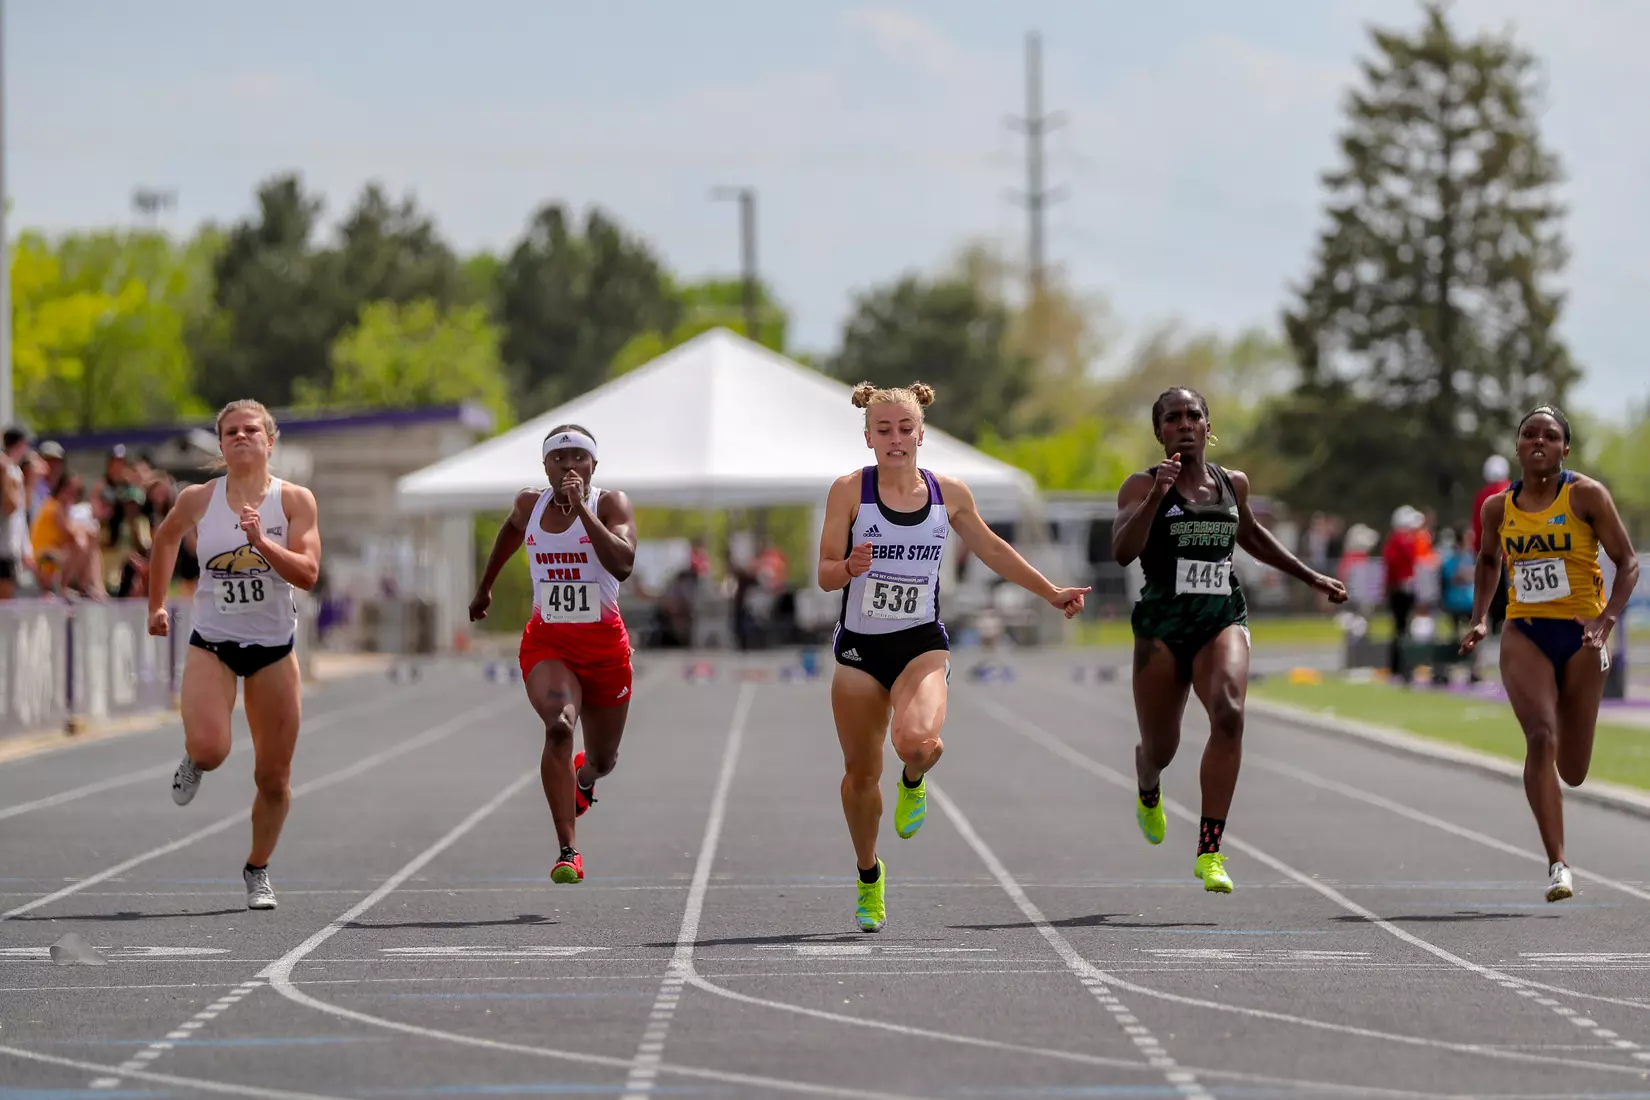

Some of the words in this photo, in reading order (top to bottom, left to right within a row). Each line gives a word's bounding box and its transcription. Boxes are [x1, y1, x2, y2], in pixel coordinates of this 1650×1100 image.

[1178, 533, 1231, 547] STATE
[1505, 533, 1571, 554] NAU
[872, 544, 905, 560] EBER
[907, 545, 941, 560] STATE
[1186, 563, 1224, 588] 445
[1521, 564, 1559, 591] 356
[222, 580, 265, 603] 318
[549, 585, 590, 612] 491
[873, 582, 918, 613] 538
[842, 652, 862, 661] adidas
